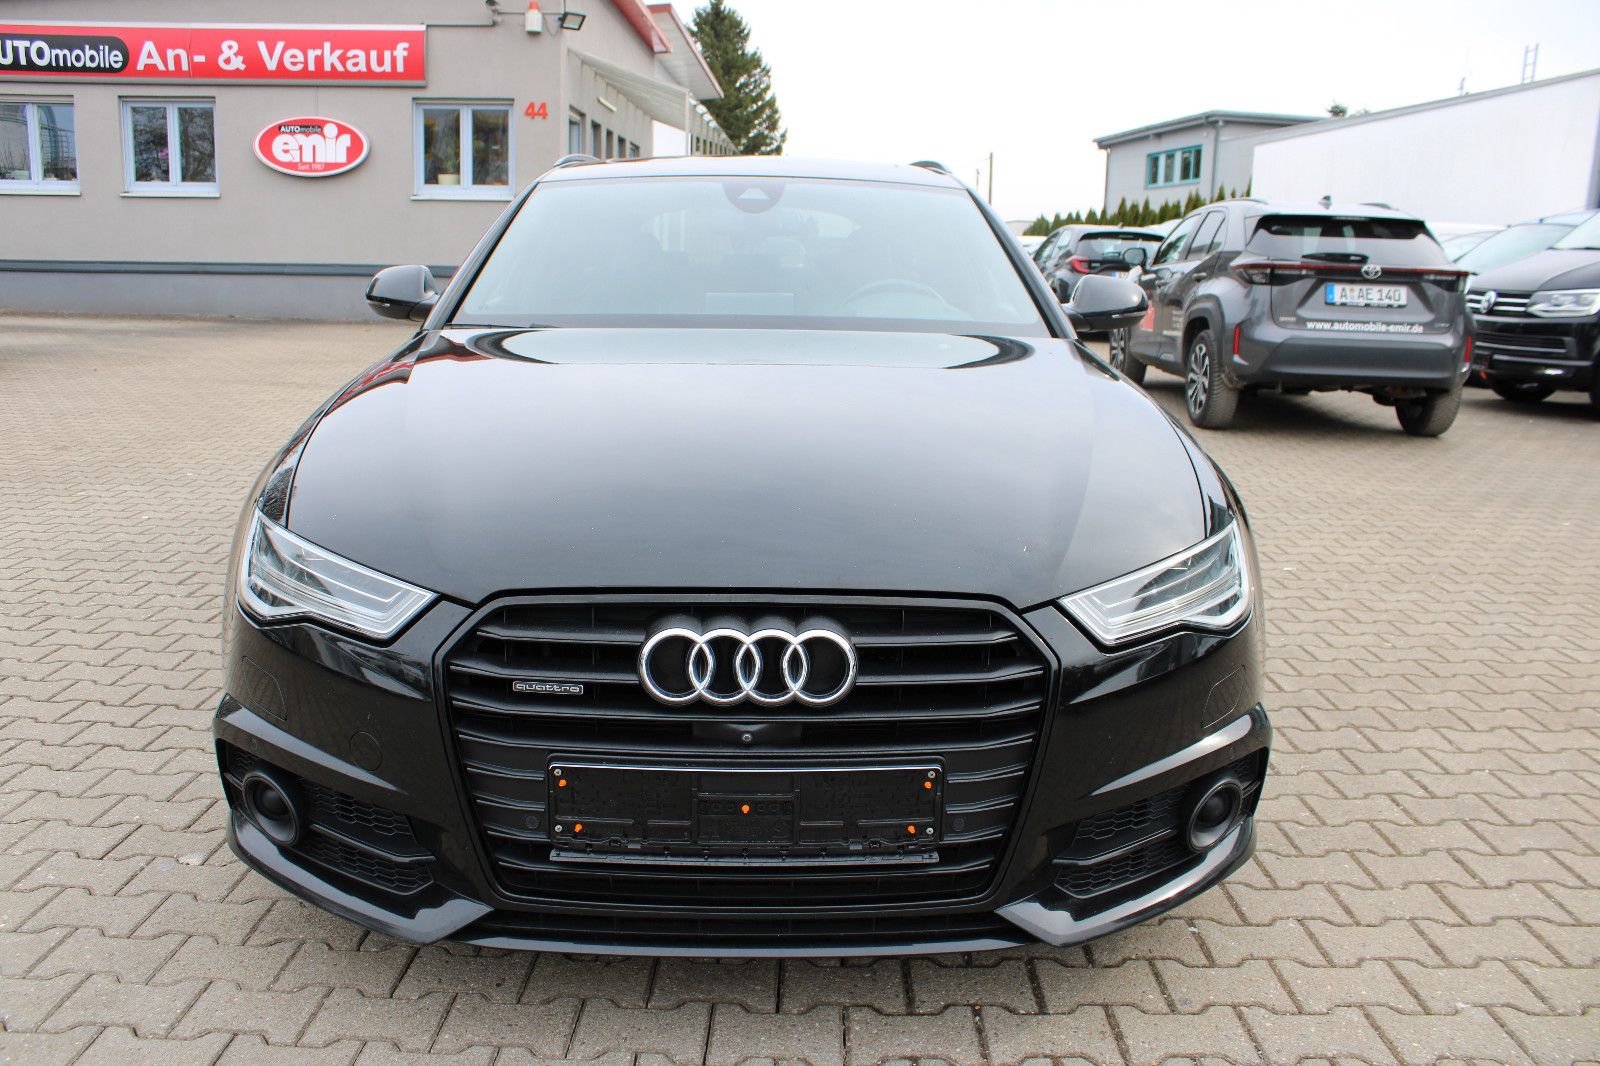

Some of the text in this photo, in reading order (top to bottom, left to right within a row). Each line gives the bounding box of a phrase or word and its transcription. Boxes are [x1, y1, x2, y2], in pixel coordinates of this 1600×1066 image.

[136, 40, 409, 73] An- & Verkauf
[524, 101, 548, 119] 44
[272, 123, 351, 163] emir
[1377, 289, 1401, 302] 140
[1306, 321, 1424, 333] www.automobile-emir.de
[516, 684, 580, 692] quattro
